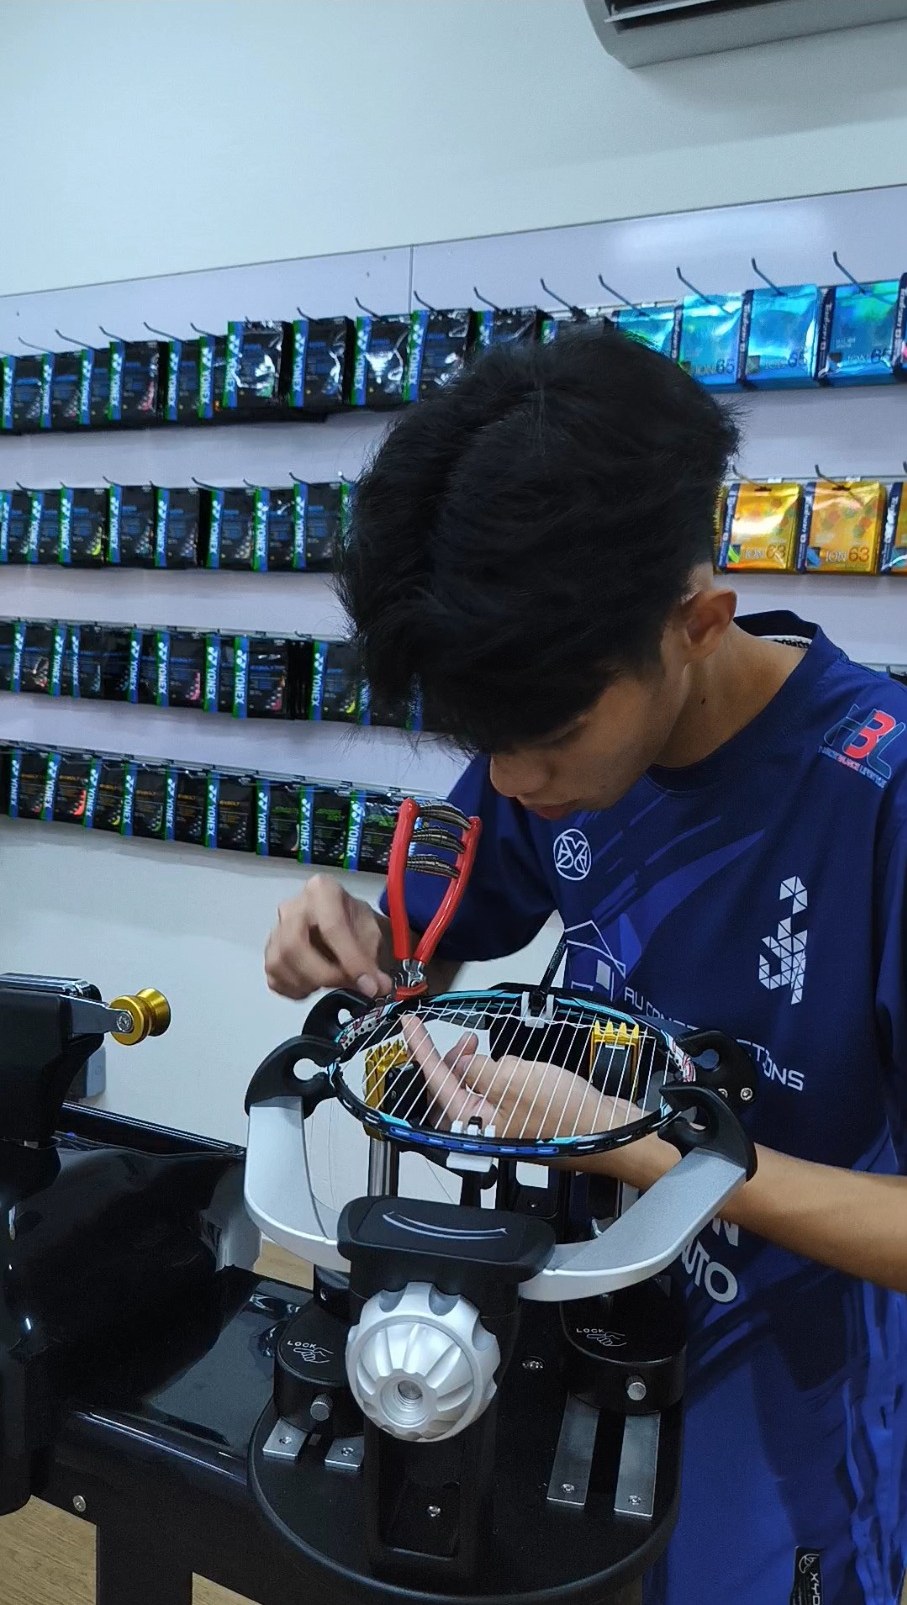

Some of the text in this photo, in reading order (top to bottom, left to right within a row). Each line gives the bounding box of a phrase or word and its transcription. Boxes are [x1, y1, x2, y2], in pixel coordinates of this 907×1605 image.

[826, 547, 870, 562] ION 63
[158, 662, 167, 694] YONEX
[206, 667, 217, 700] YONEX
[235, 670, 245, 704] YONEX
[311, 673, 322, 706] YONEX
[43, 780, 55, 808] YONEX
[85, 788, 96, 817] YONEX
[123, 794, 133, 824] YONEX
[165, 798, 174, 828] YONEX
[207, 804, 216, 836] YONEX
[257, 812, 267, 843] YONEX
[300, 820, 310, 852] YONEX
[346, 825, 360, 858] YONEX
[287, 1340, 317, 1349] LOCK
